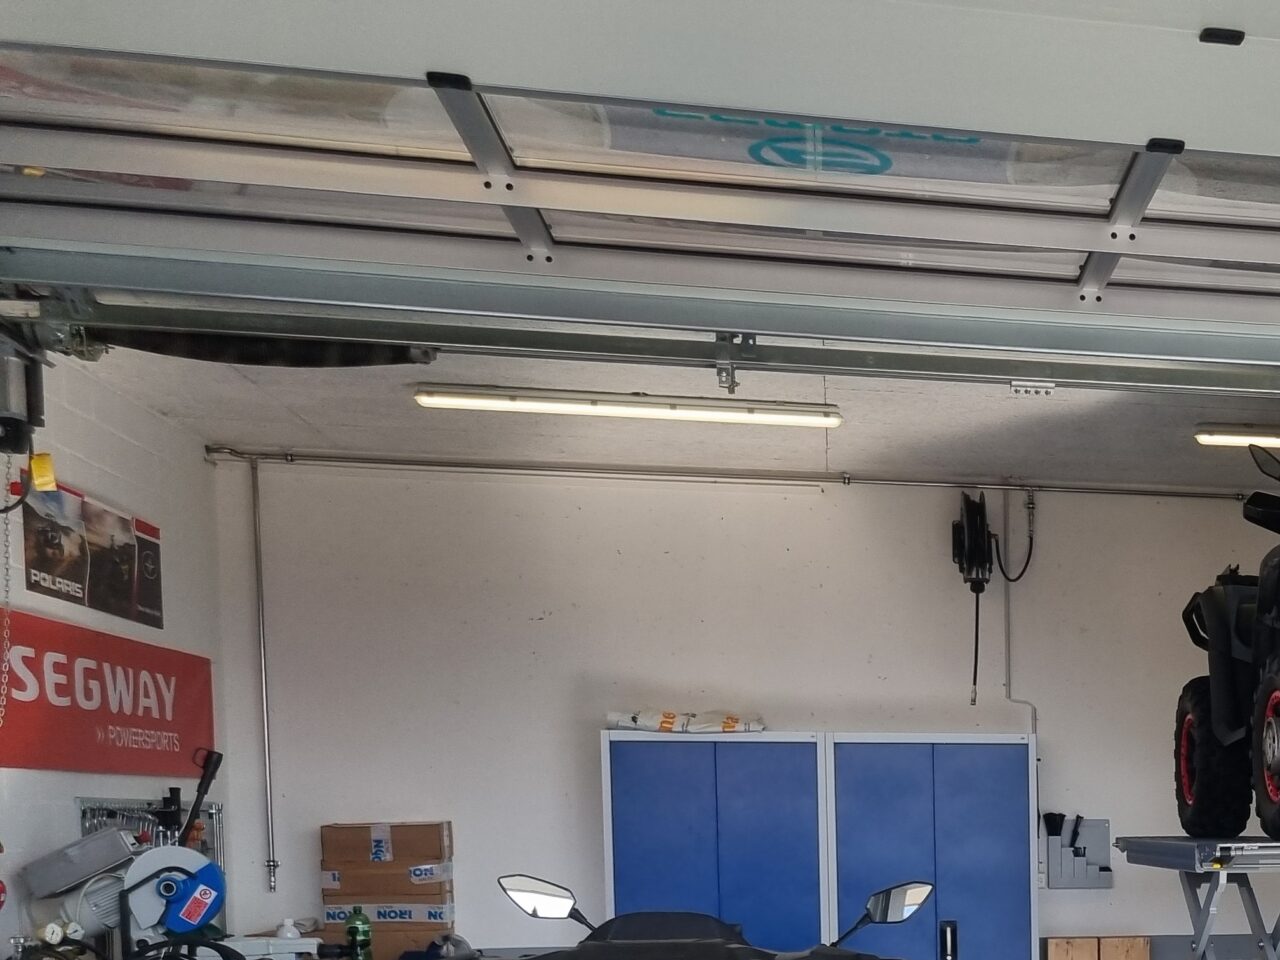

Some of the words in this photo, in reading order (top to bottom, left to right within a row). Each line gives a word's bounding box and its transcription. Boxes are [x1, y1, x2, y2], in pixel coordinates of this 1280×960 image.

[30, 569, 83, 597] POLARIS
[9, 645, 177, 722] SEGWAY
[108, 725, 180, 752] POWERSPORTS
[377, 910, 413, 920] IRON
